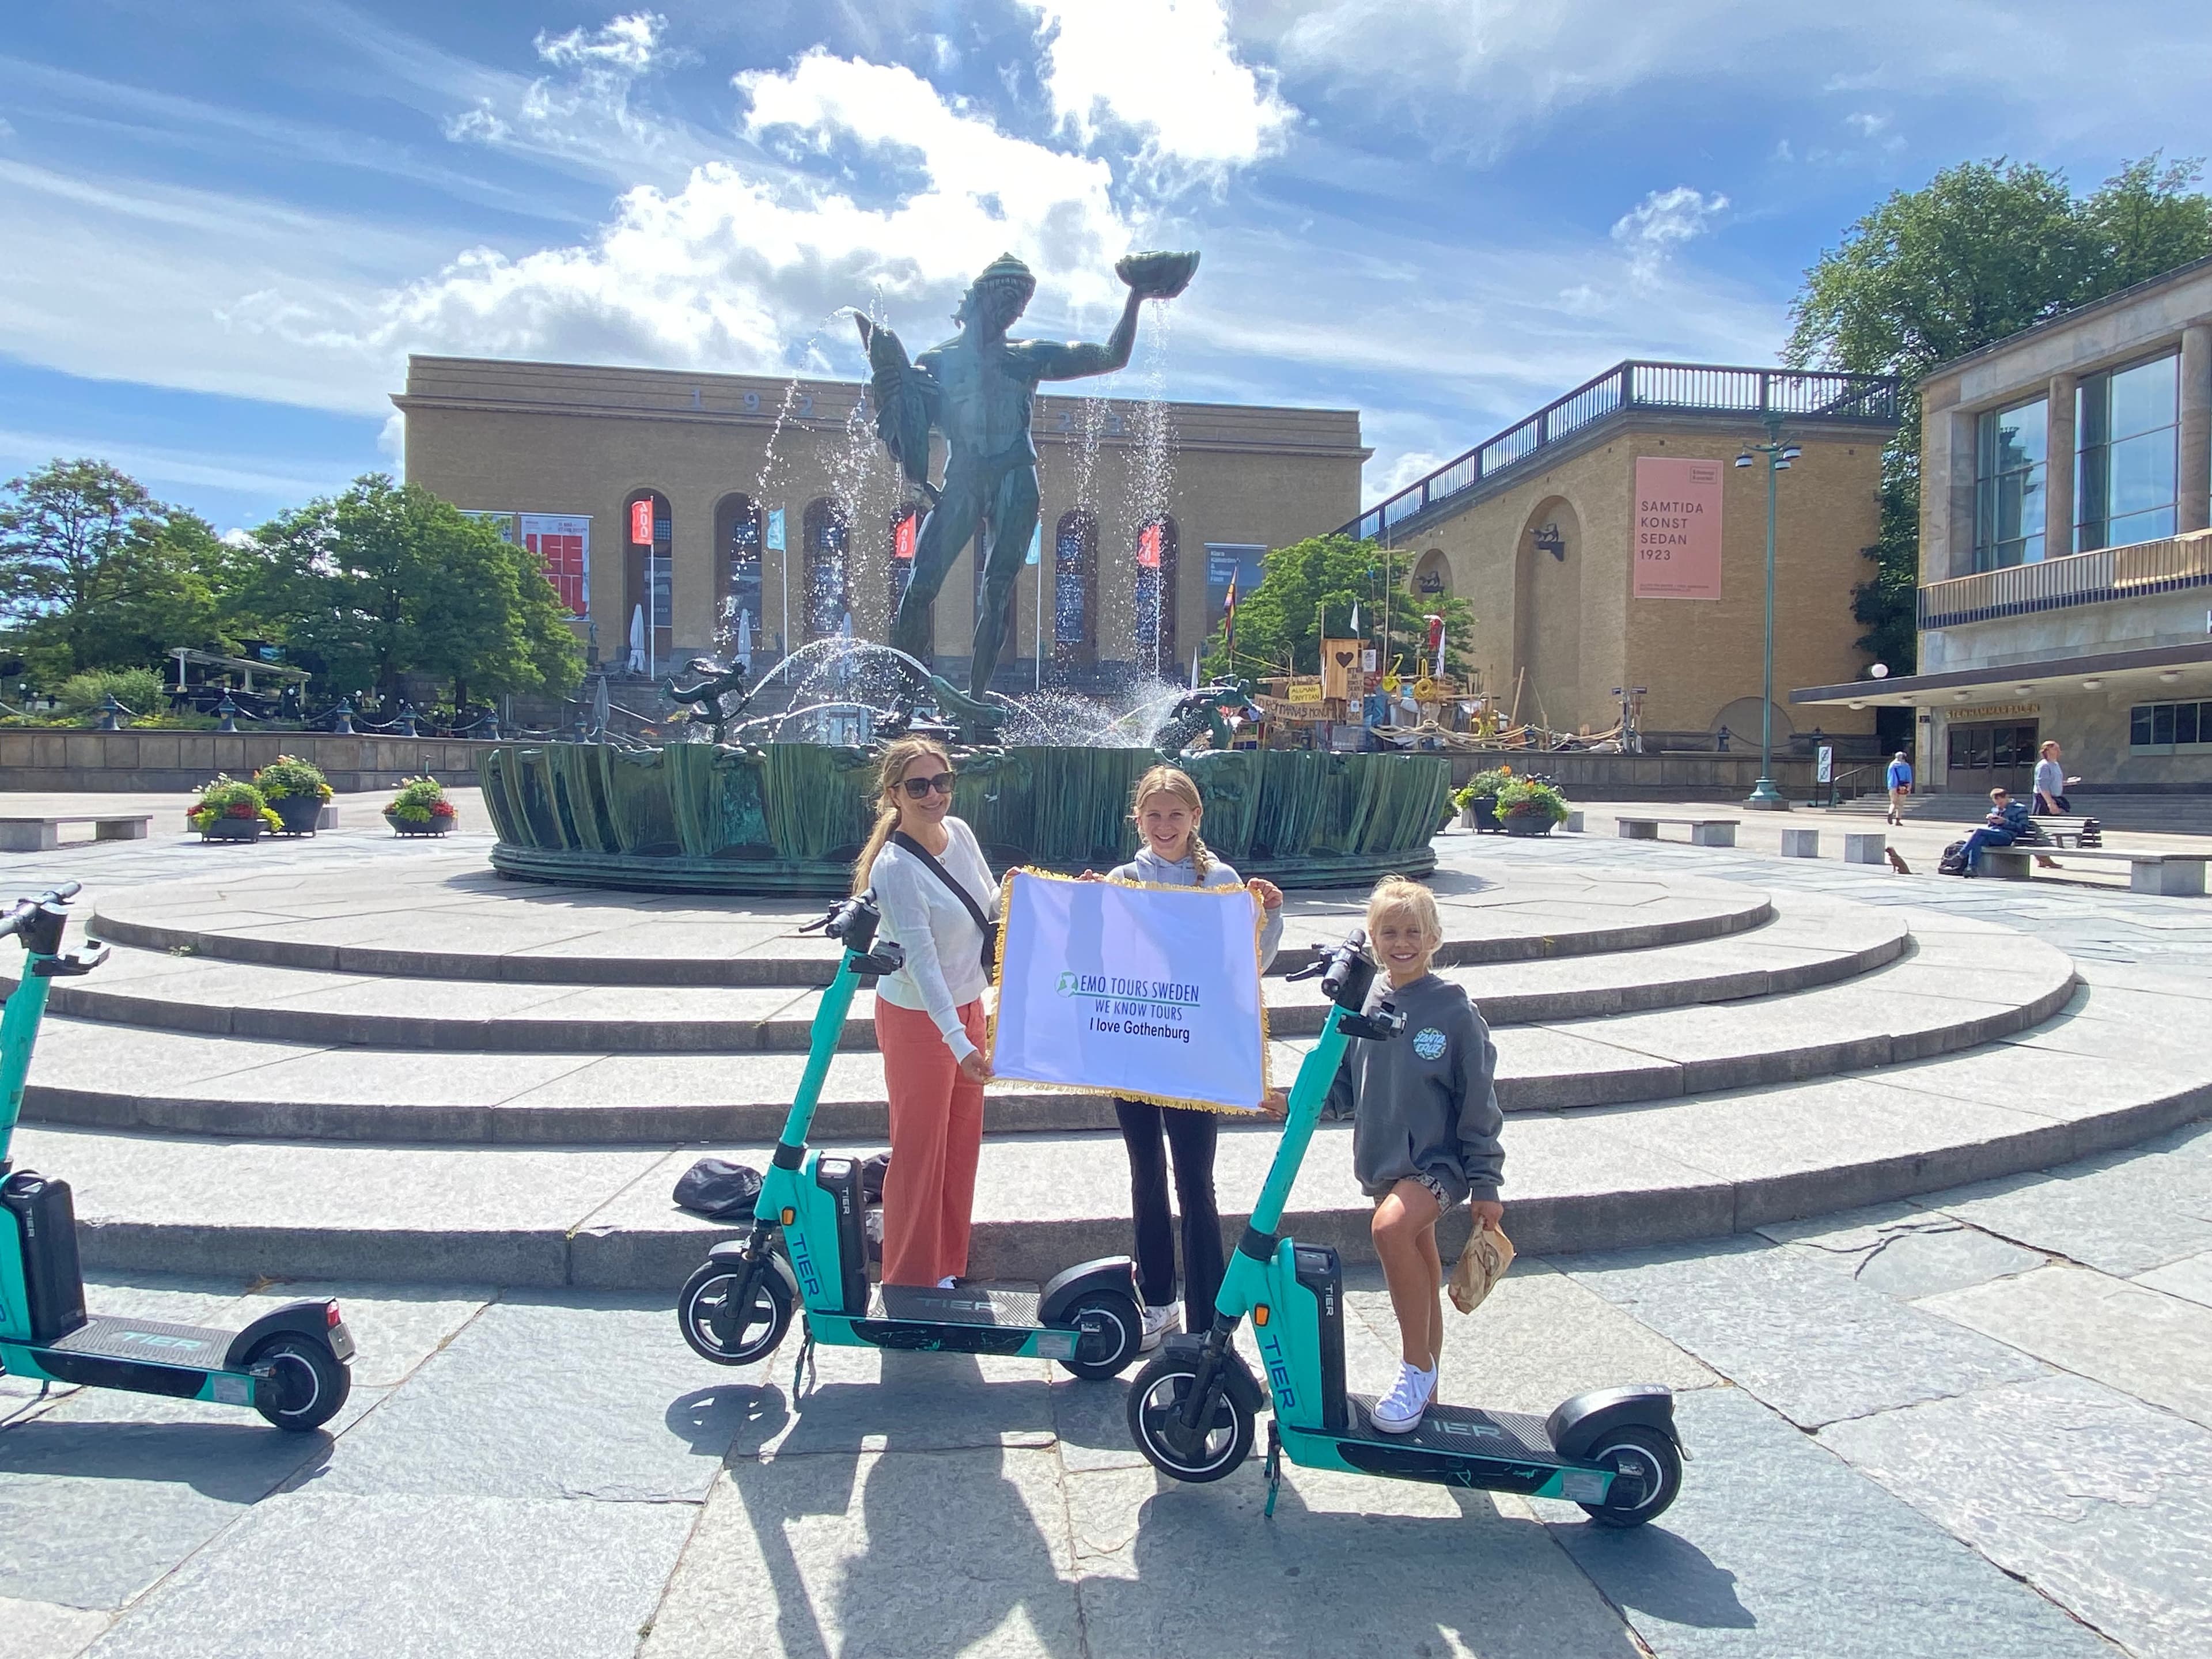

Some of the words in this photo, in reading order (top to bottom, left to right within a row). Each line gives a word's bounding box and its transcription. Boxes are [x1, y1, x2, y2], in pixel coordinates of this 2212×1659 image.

[1641, 501, 1704, 514] SAMTIDA
[1641, 517, 1688, 529] KONST
[1641, 533, 1687, 545] SEDAN
[1640, 550, 1671, 560] 1923
[1946, 703, 2040, 718] STENHAMMARSALEN
[1111, 978, 1148, 998] TOURS
[1152, 981, 1199, 1002] SWEDEN
[1096, 999, 1110, 1014] WE
[1114, 1001, 1147, 1017] KNOW
[1151, 1004, 1183, 1021] TOURS
[1089, 1017, 1094, 1031] I
[1097, 1018, 1120, 1033] love
[1124, 1020, 1190, 1043] Gothenburg
[842, 1186, 851, 1215] TIER
[25, 1207, 35, 1237] TIER
[793, 1233, 820, 1297] TIER
[916, 1297, 999, 1312] TIER
[1325, 1283, 1334, 1317] TIER
[122, 1331, 202, 1351] TIER
[1265, 1334, 1296, 1411] TIER
[1432, 1419, 1503, 1440] IER
